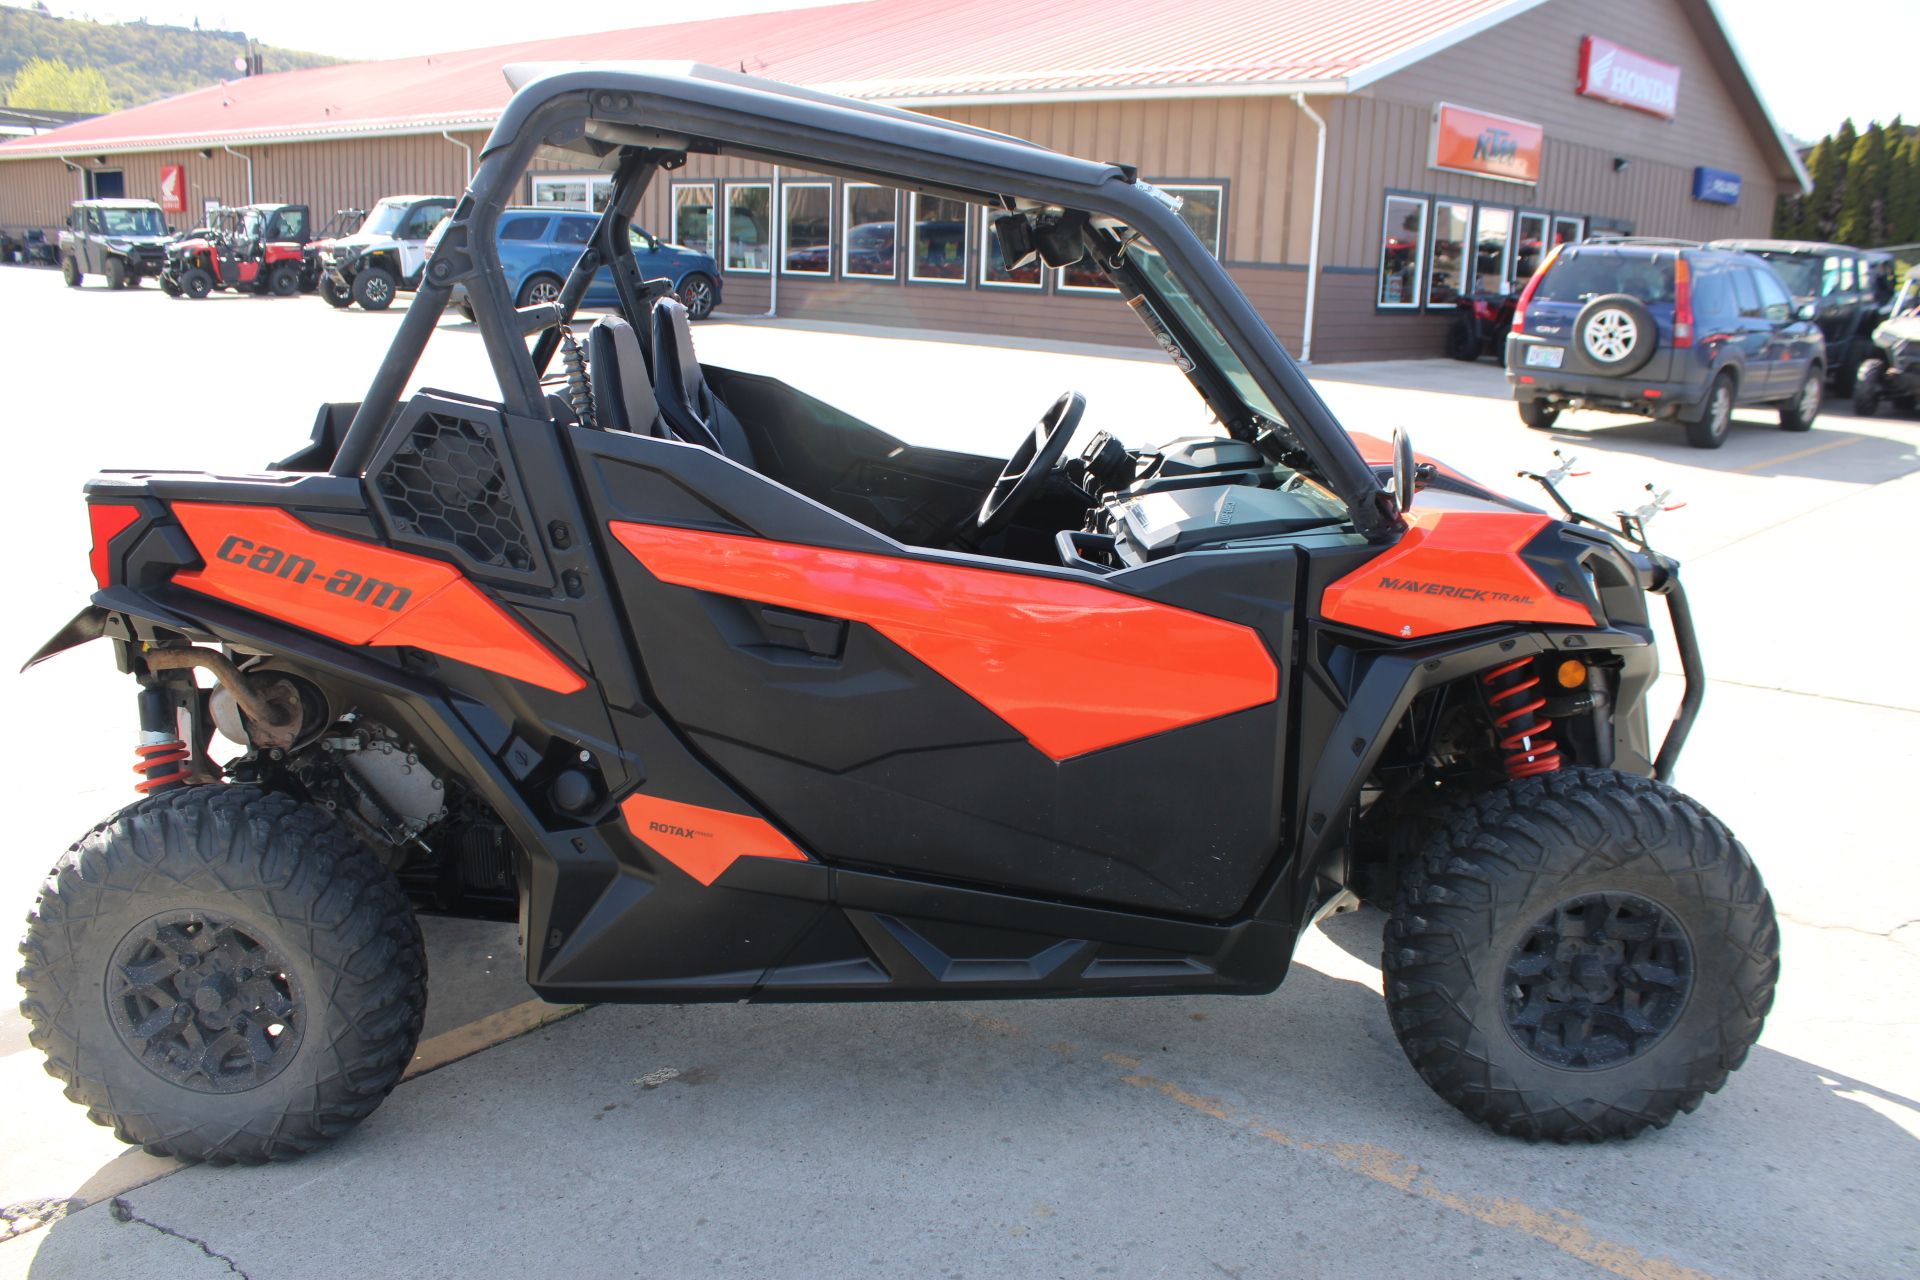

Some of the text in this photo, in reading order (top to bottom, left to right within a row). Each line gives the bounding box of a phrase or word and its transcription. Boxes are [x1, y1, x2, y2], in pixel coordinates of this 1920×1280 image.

[1610, 66, 1674, 109] HONDA
[1473, 127, 1518, 163] KTM
[216, 534, 413, 612] can-am
[1378, 577, 1534, 604] MAVERICK TRAIL
[649, 821, 695, 839] ROTAX
